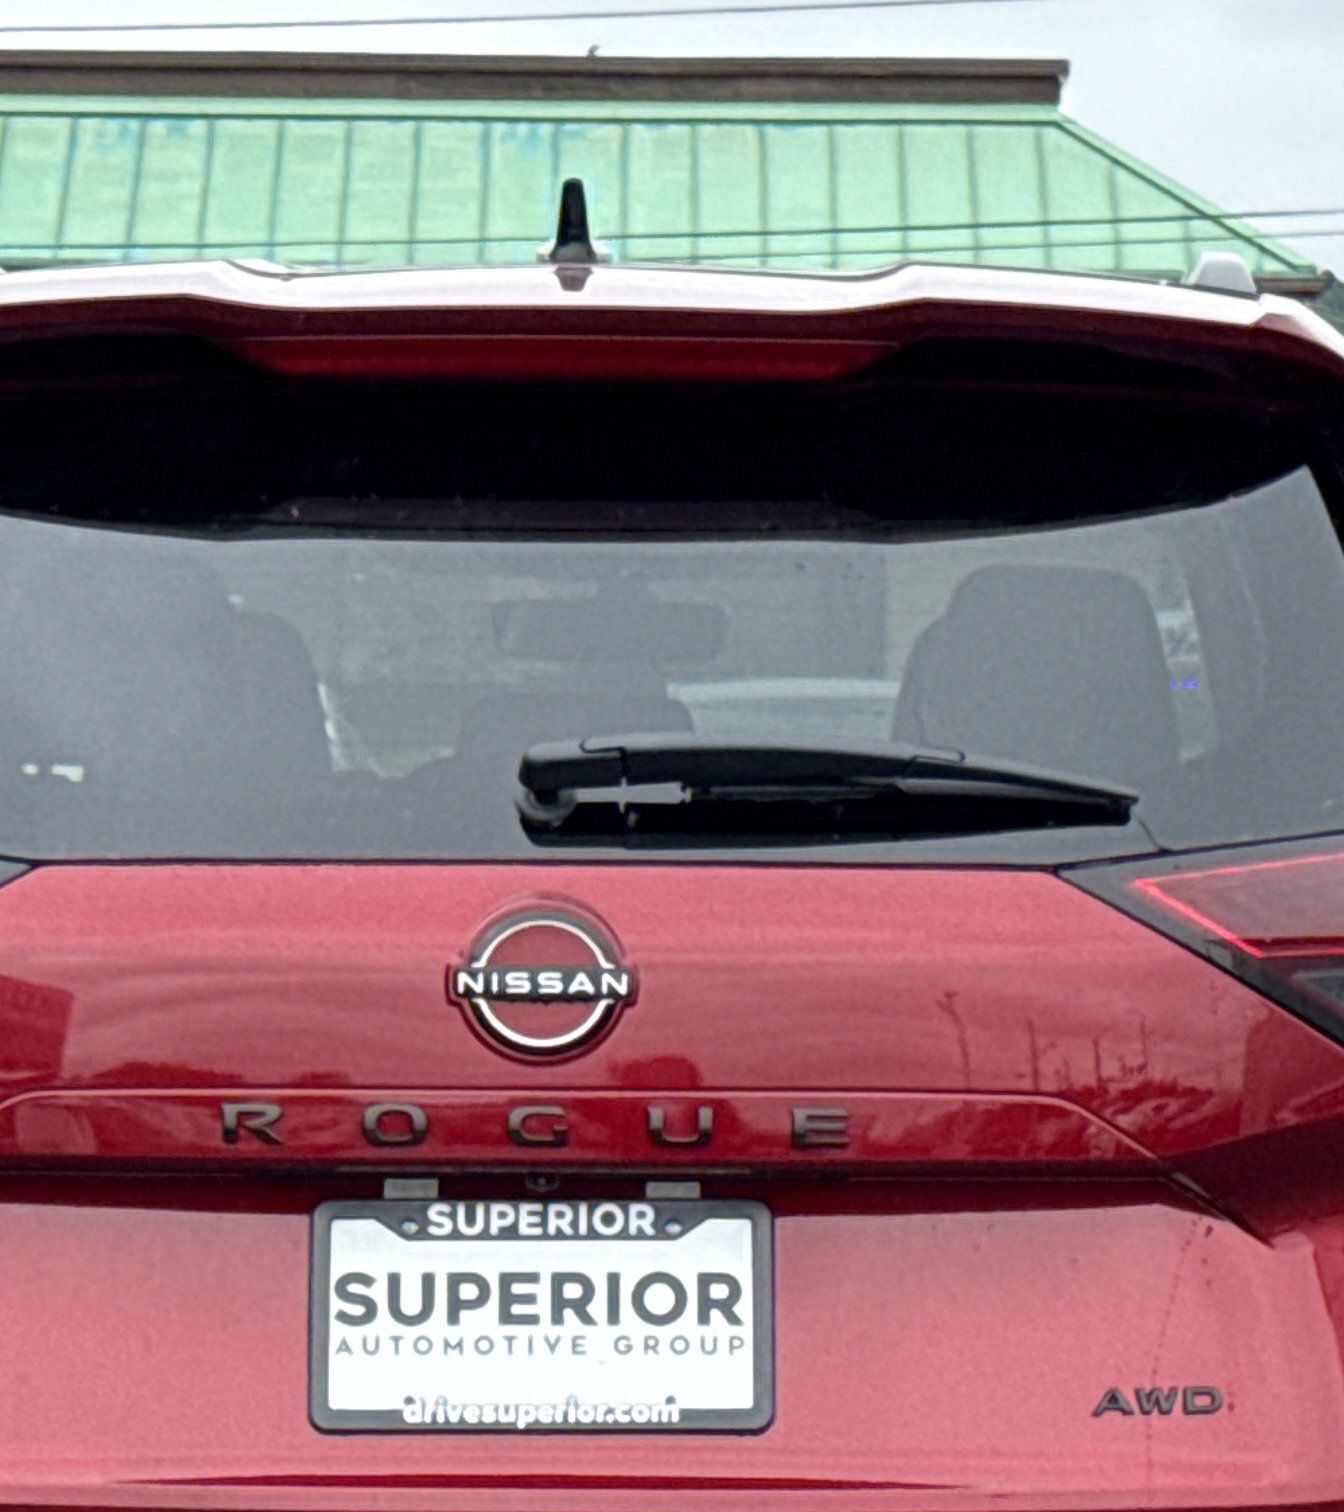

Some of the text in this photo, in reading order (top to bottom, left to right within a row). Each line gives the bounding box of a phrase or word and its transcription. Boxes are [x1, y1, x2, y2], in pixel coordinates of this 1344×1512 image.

[456, 969, 629, 996] NISSAN
[220, 1101, 850, 1149] ROGUE
[426, 1202, 656, 1237] SUPERIOR
[333, 1271, 745, 1327] SUPERIOR
[334, 1334, 746, 1356] AUTOMOTIVE GROUP
[402, 1395, 681, 1430] drivesuperior.com
[1091, 1385, 1224, 1418] AWD
